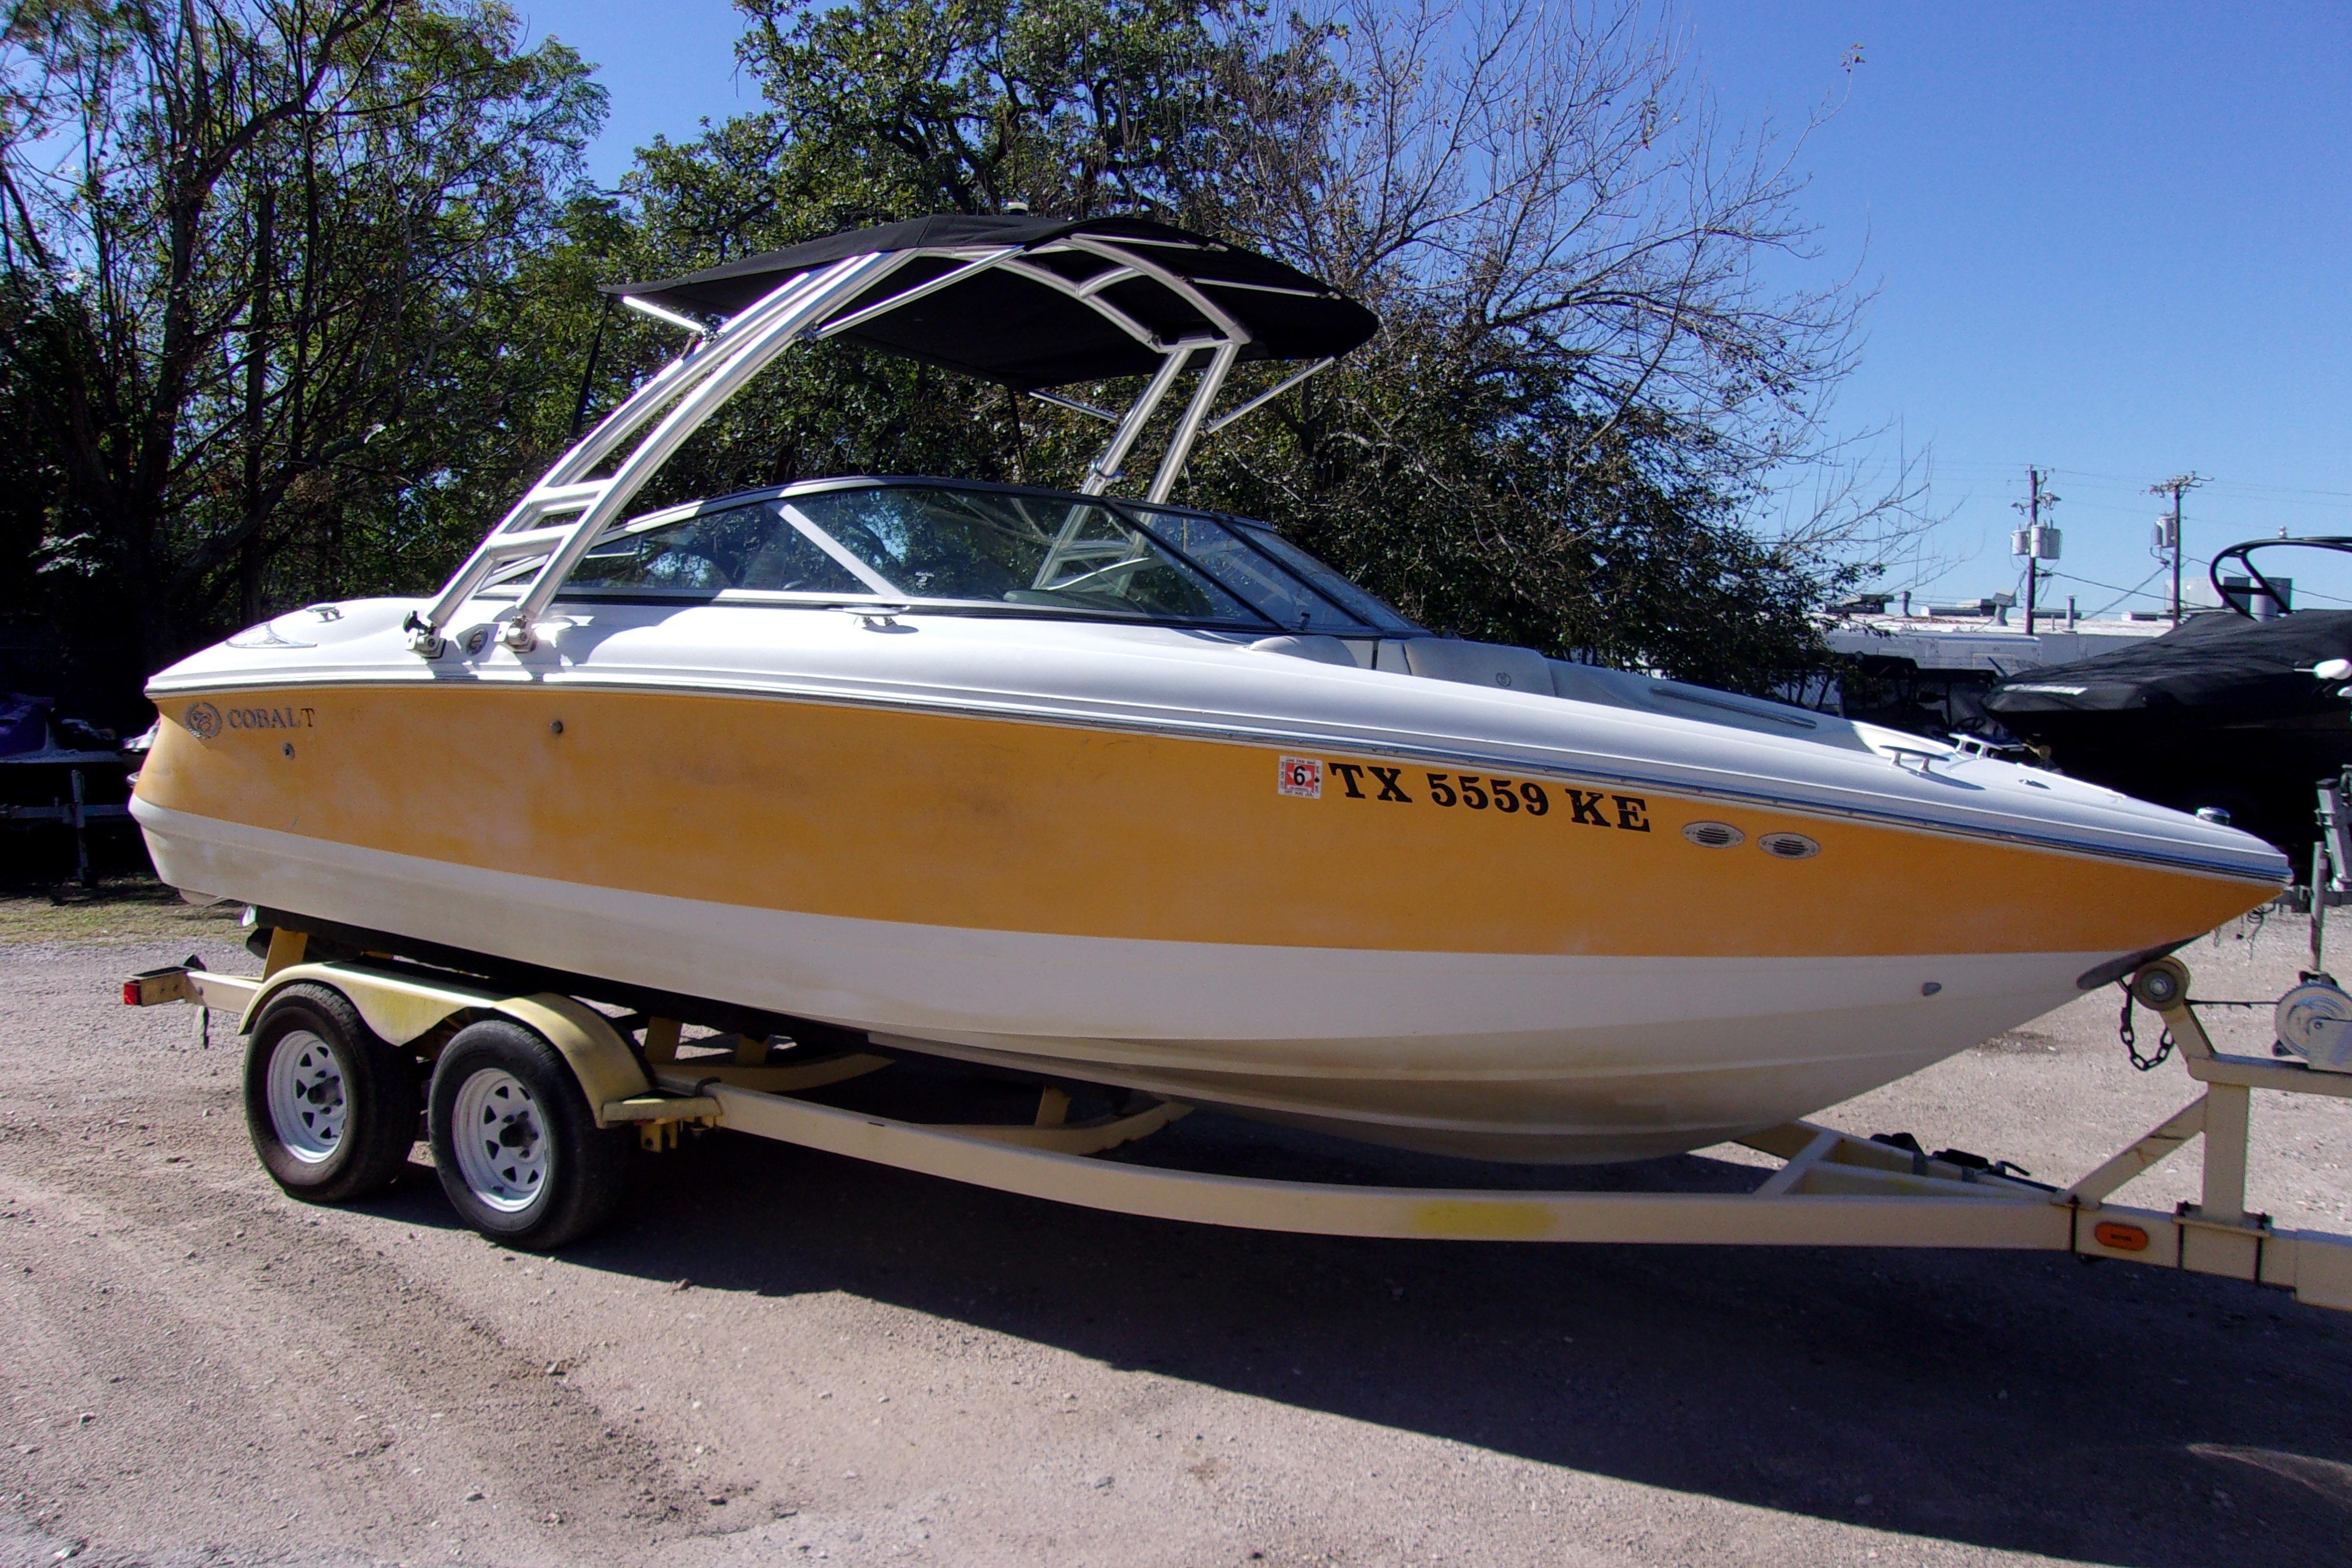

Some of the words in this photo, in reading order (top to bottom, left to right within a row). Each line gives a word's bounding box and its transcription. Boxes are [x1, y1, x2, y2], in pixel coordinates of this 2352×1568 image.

[227, 707, 315, 728] COBALT
[1294, 766, 1305, 786] 6
[1328, 762, 1413, 803] TX
[1426, 772, 1549, 816] 5559
[1565, 788, 1650, 832] KE
